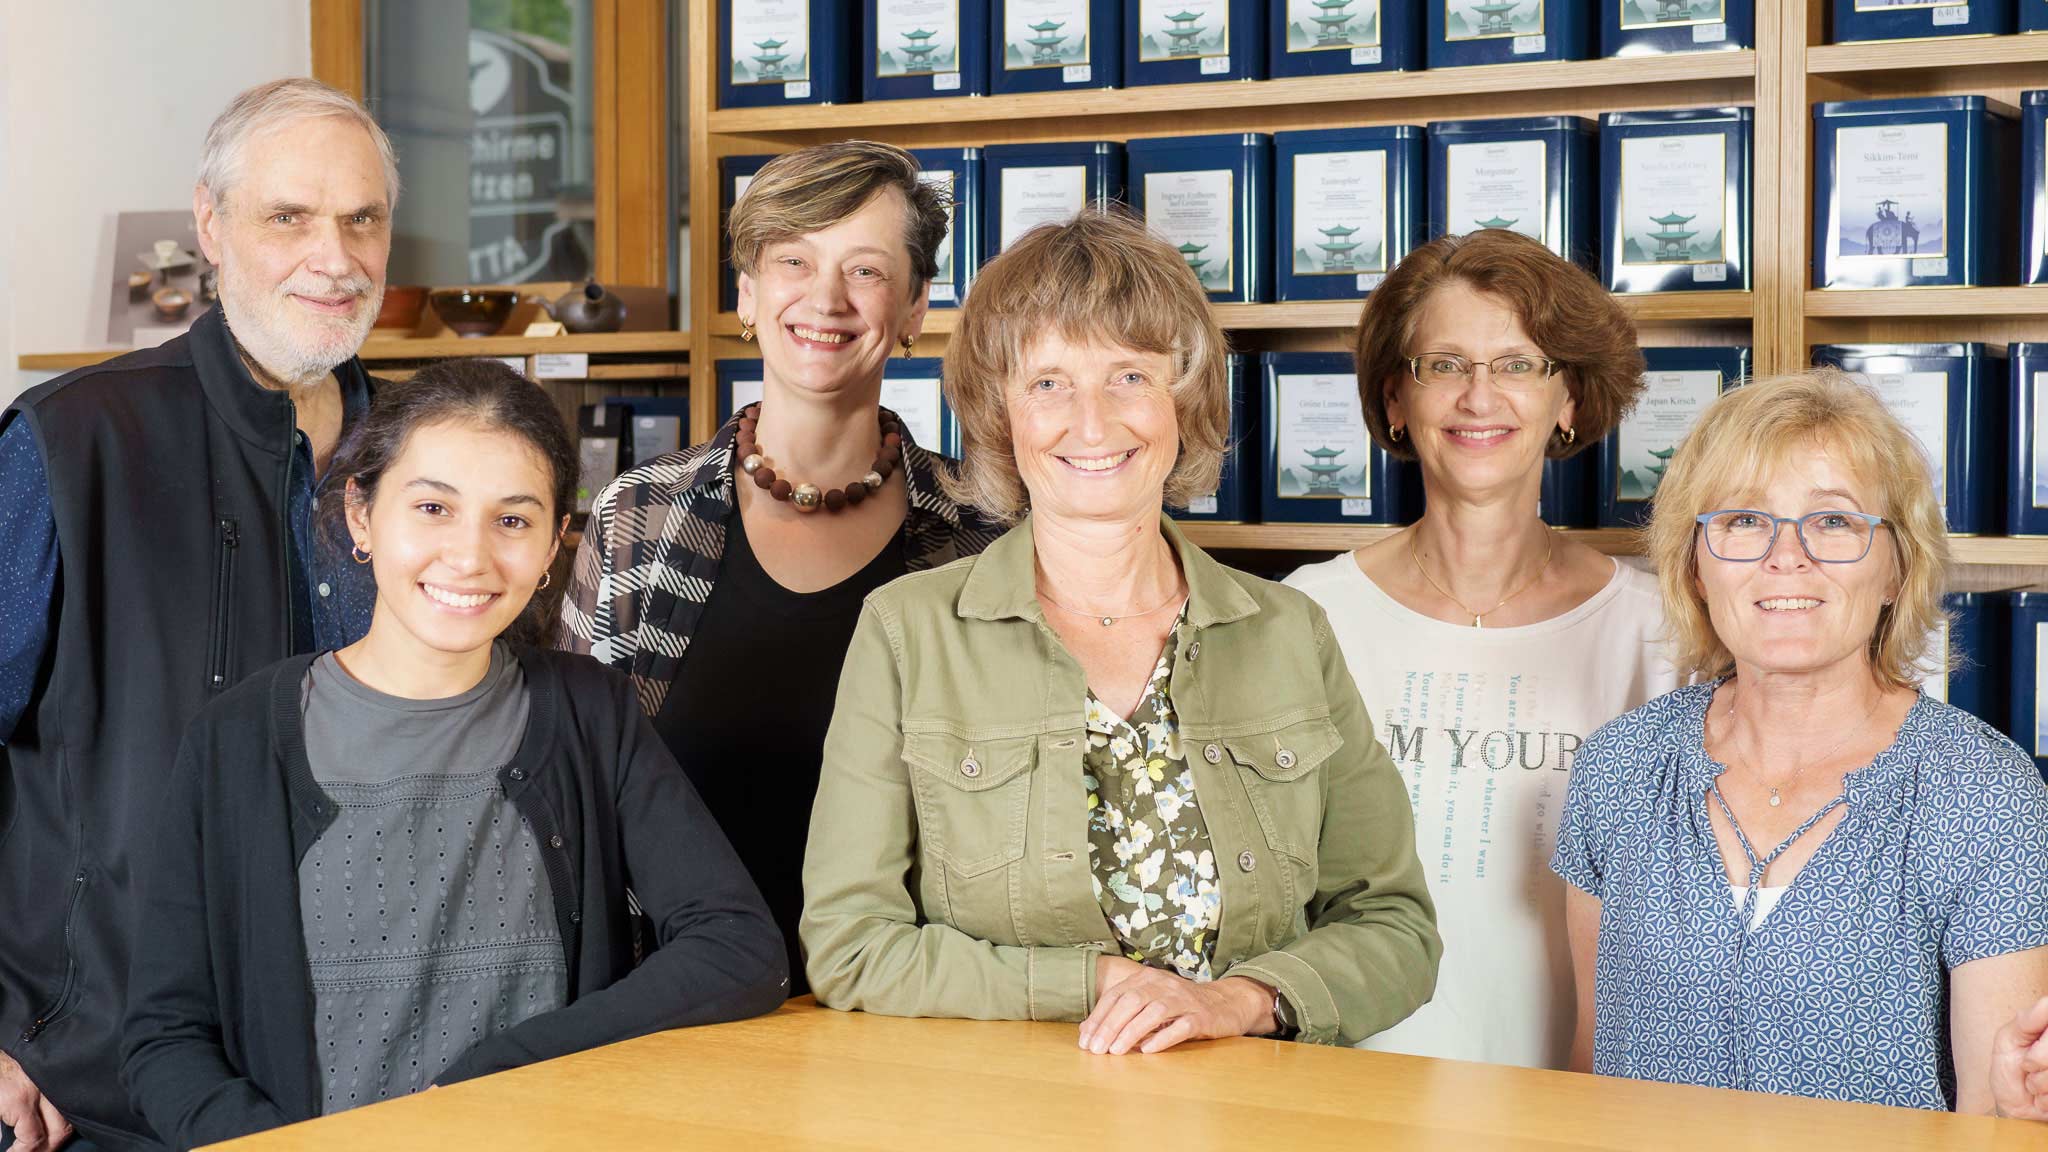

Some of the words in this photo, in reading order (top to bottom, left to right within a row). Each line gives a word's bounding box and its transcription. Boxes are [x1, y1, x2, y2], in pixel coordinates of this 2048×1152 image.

[470, 131, 555, 161] hirme
[1646, 397, 1668, 407] Japan
[1404, 672, 1418, 704] Never
[1422, 672, 1435, 698] Your
[1457, 673, 1470, 683] If
[1509, 674, 1521, 694] You
[1454, 687, 1465, 712] your
[1508, 700, 1517, 718] are
[1420, 702, 1430, 720] are
[1445, 800, 1456, 821] you
[1480, 778, 1497, 834] whatever
[1443, 826, 1454, 848] can
[1442, 854, 1454, 869] do
[1476, 850, 1488, 879] want
[1440, 874, 1451, 884] it
